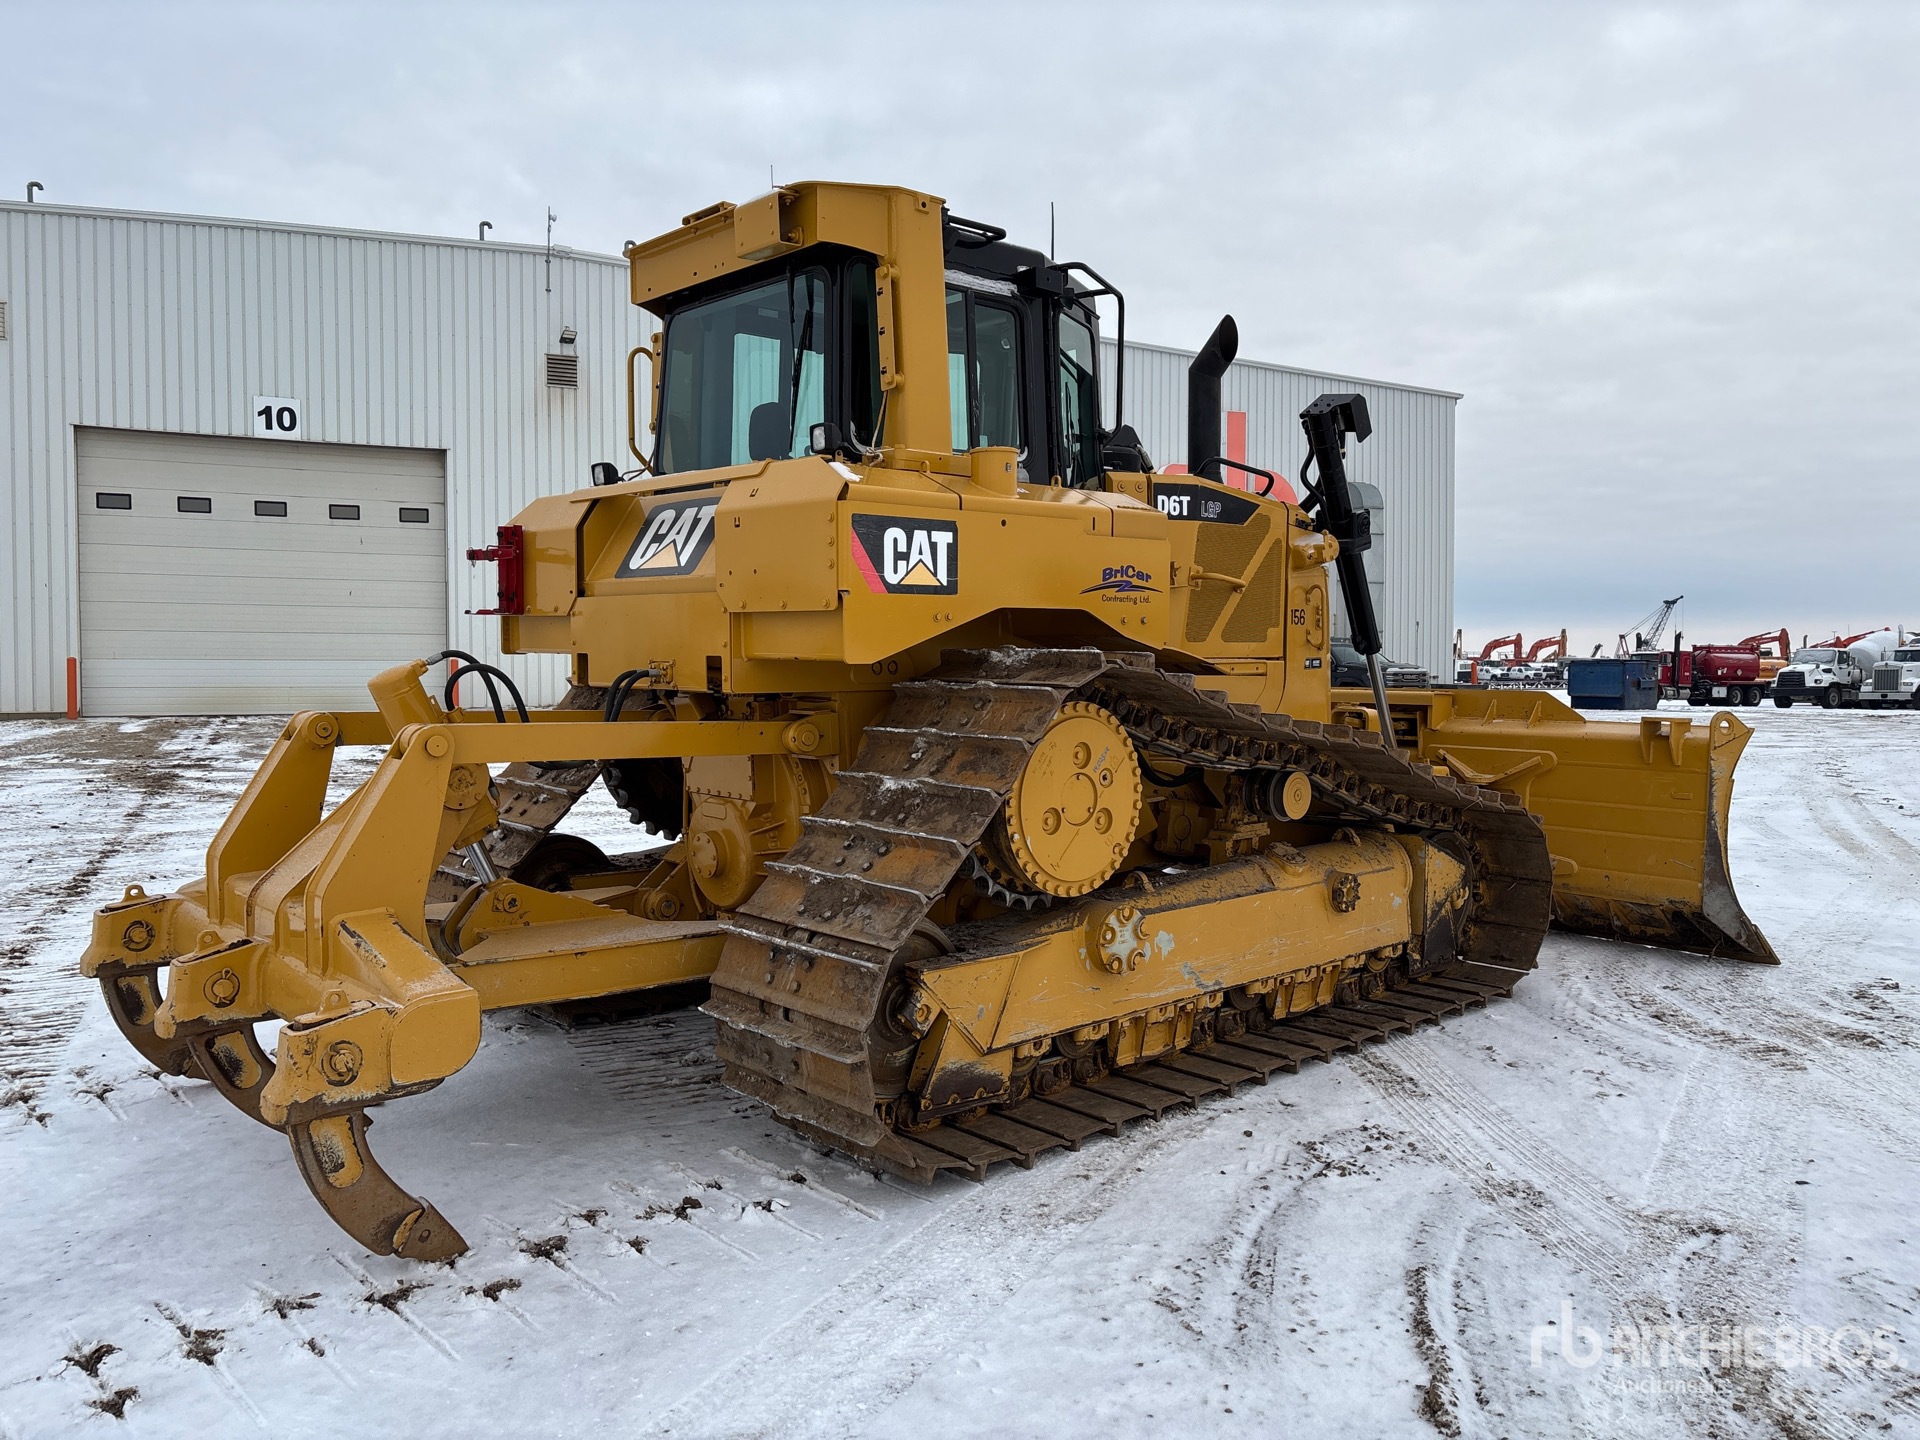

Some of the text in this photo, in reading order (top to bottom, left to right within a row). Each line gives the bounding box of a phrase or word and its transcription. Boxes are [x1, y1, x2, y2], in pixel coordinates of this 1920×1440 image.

[257, 405, 298, 432] 10
[1157, 495, 1222, 518] D6T LGP
[628, 504, 719, 571] CAT
[883, 526, 954, 587] CAT
[1101, 564, 1152, 583] BriCar
[1101, 594, 1152, 606] Contracting Ltd.
[1290, 608, 1306, 626] 156
